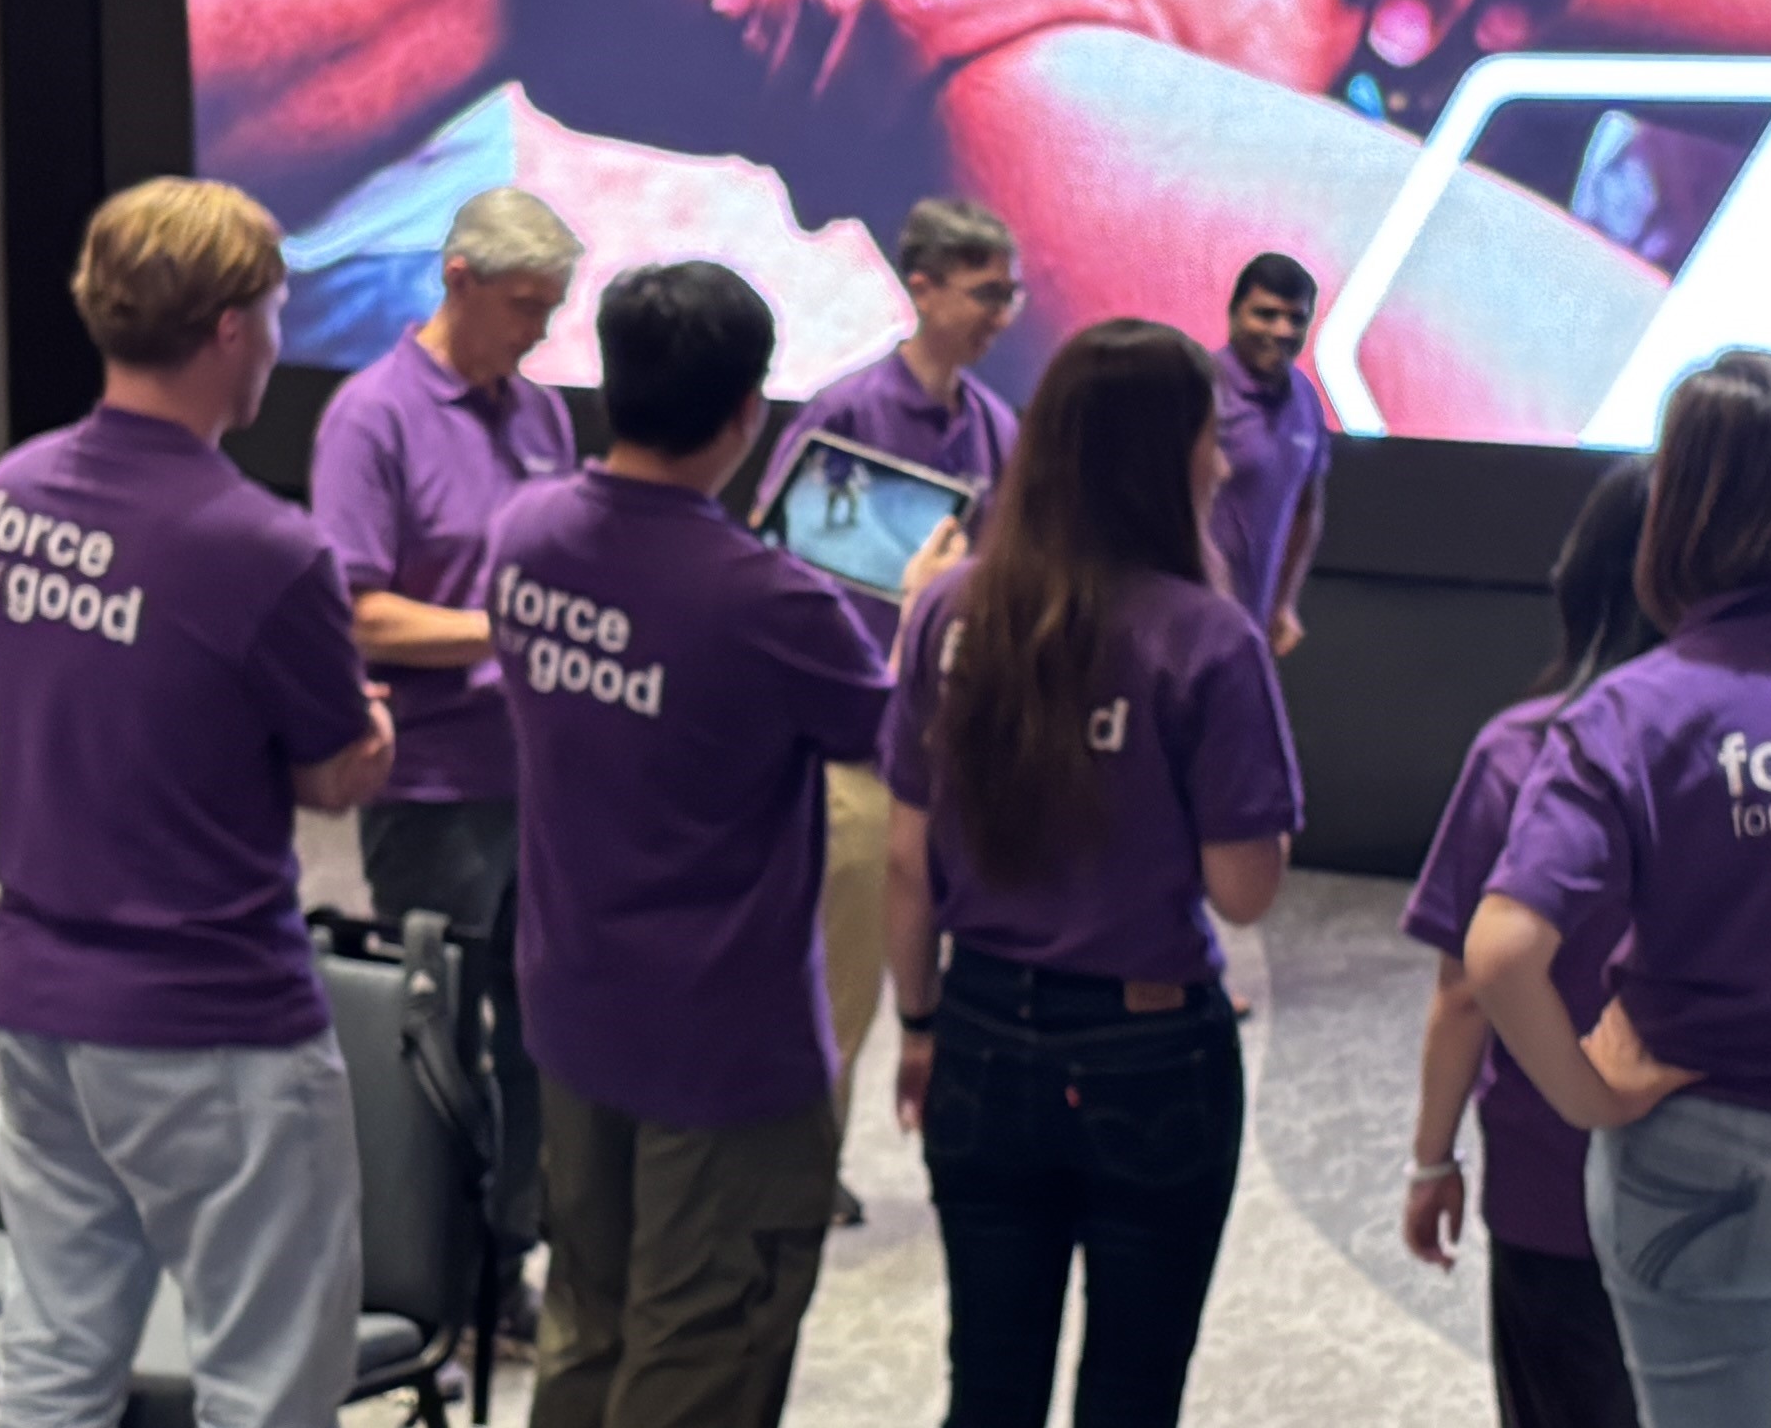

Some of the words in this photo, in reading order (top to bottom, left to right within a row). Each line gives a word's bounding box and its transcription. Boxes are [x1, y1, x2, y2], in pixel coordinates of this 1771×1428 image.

[6, 563, 143, 646] good
[498, 564, 630, 653] force
[530, 637, 664, 717] good
